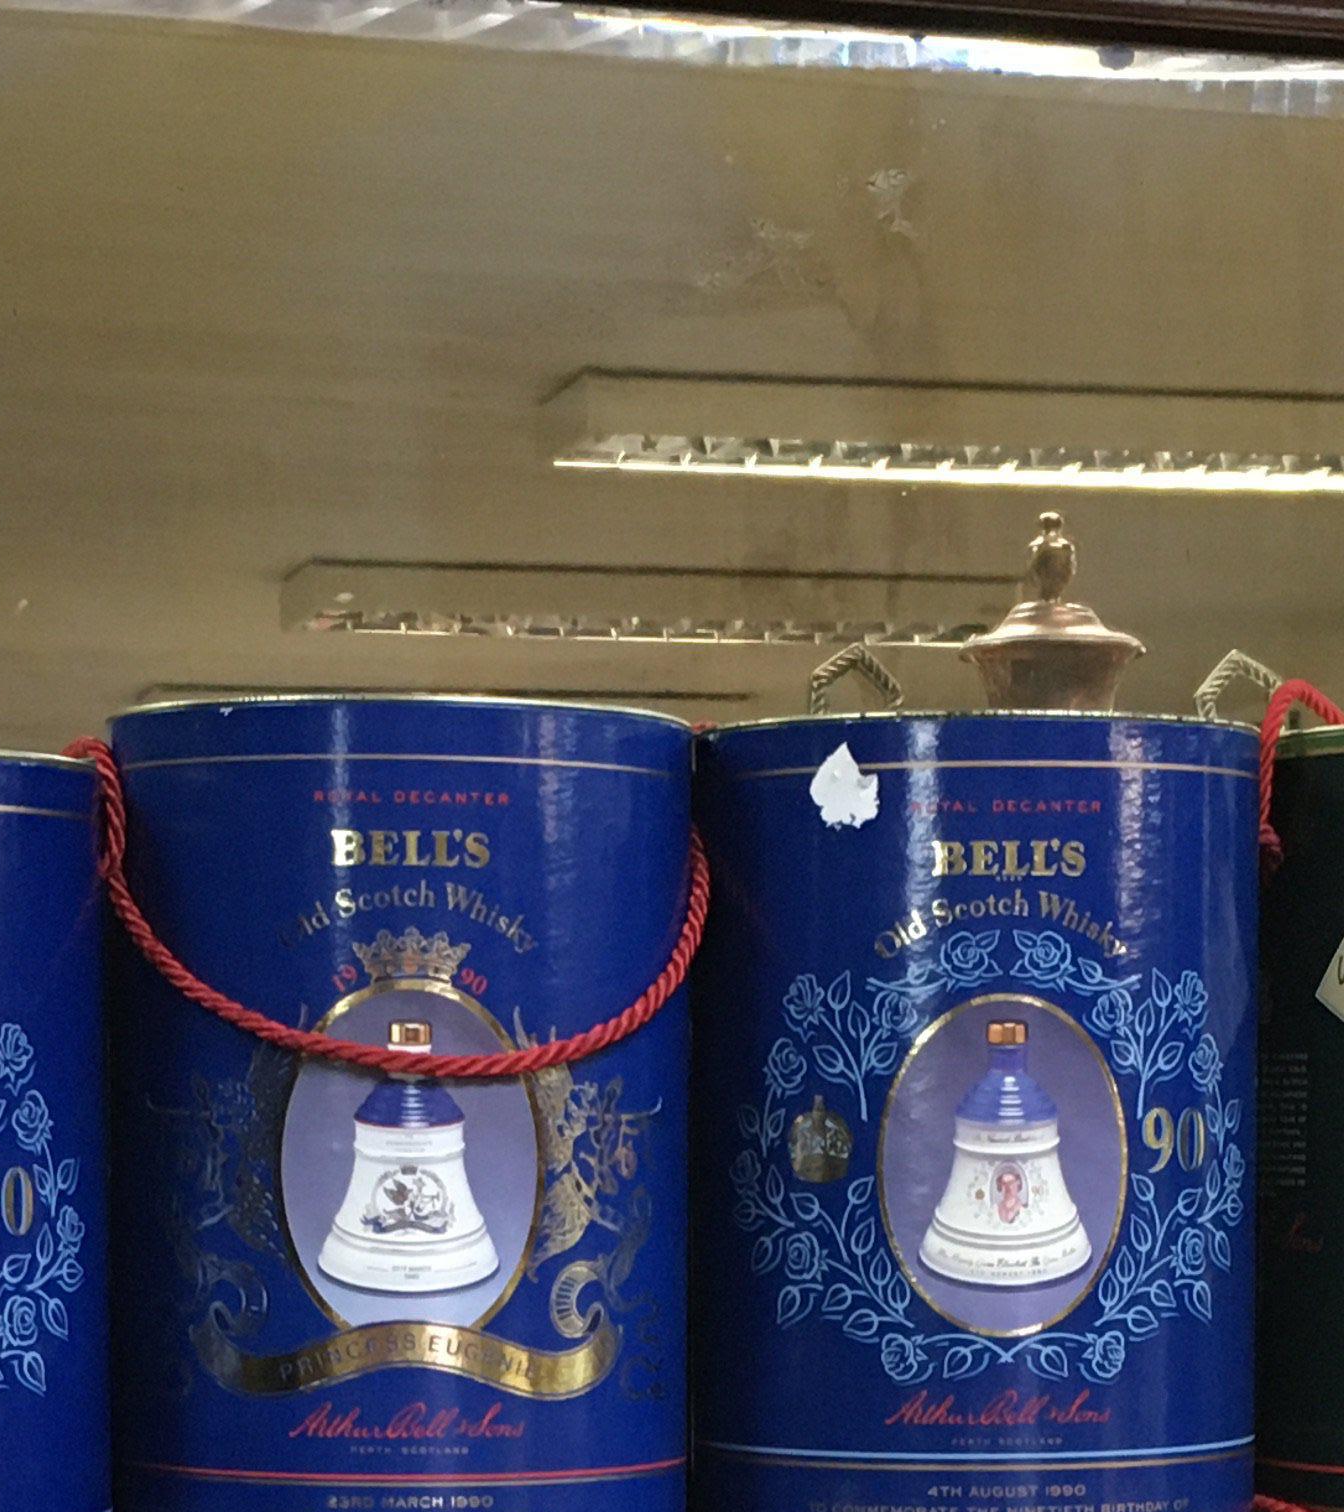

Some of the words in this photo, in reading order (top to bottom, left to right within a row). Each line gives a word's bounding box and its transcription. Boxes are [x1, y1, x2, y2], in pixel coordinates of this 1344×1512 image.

[313, 790, 381, 803] ROYAL
[394, 790, 510, 807] DECANTER
[993, 800, 1101, 813] DECANTER
[330, 828, 491, 869] BELL'S
[932, 838, 1086, 877] BELL'S
[335, 879, 436, 919] Scotch
[445, 881, 539, 953] Whisky
[874, 909, 927, 960] Old
[932, 889, 1029, 927] Scotch
[1038, 890, 1129, 960] Whisky
[1143, 1107, 1206, 1174] 90
[280, 1334, 416, 1381] PRINCESS
[428, 1334, 539, 1380] EUGENIE
[968, 1485, 1038, 1498] AUGUST
